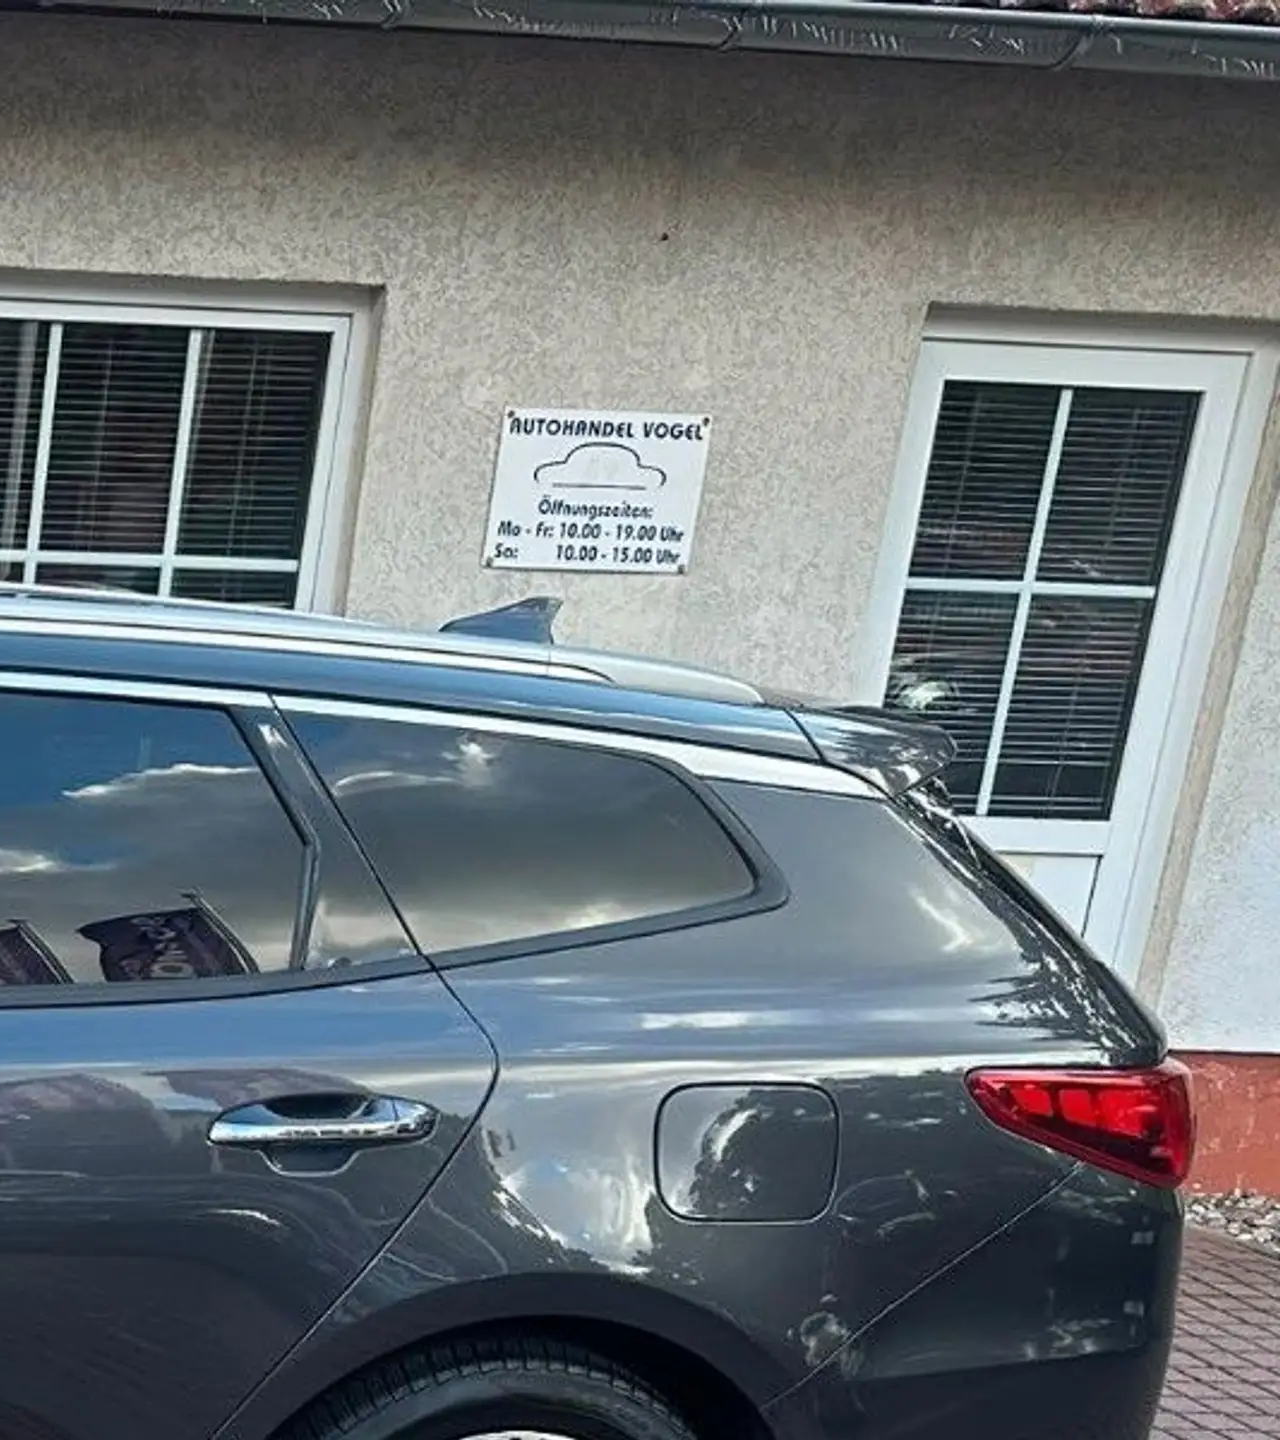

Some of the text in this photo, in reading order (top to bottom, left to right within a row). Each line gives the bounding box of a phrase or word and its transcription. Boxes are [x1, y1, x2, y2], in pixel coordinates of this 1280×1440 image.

[509, 417, 703, 441] AUTOHANDEL VOGEL
[496, 521, 521, 537] Mo
[536, 522, 555, 539] Fr:
[559, 522, 601, 539] 10.00
[615, 524, 657, 542] 19.00
[659, 525, 685, 542] Uhr
[494, 542, 519, 559] Sa:
[555, 544, 599, 562] 10.00
[612, 546, 655, 564] 15.00
[656, 547, 681, 565] Uhr
